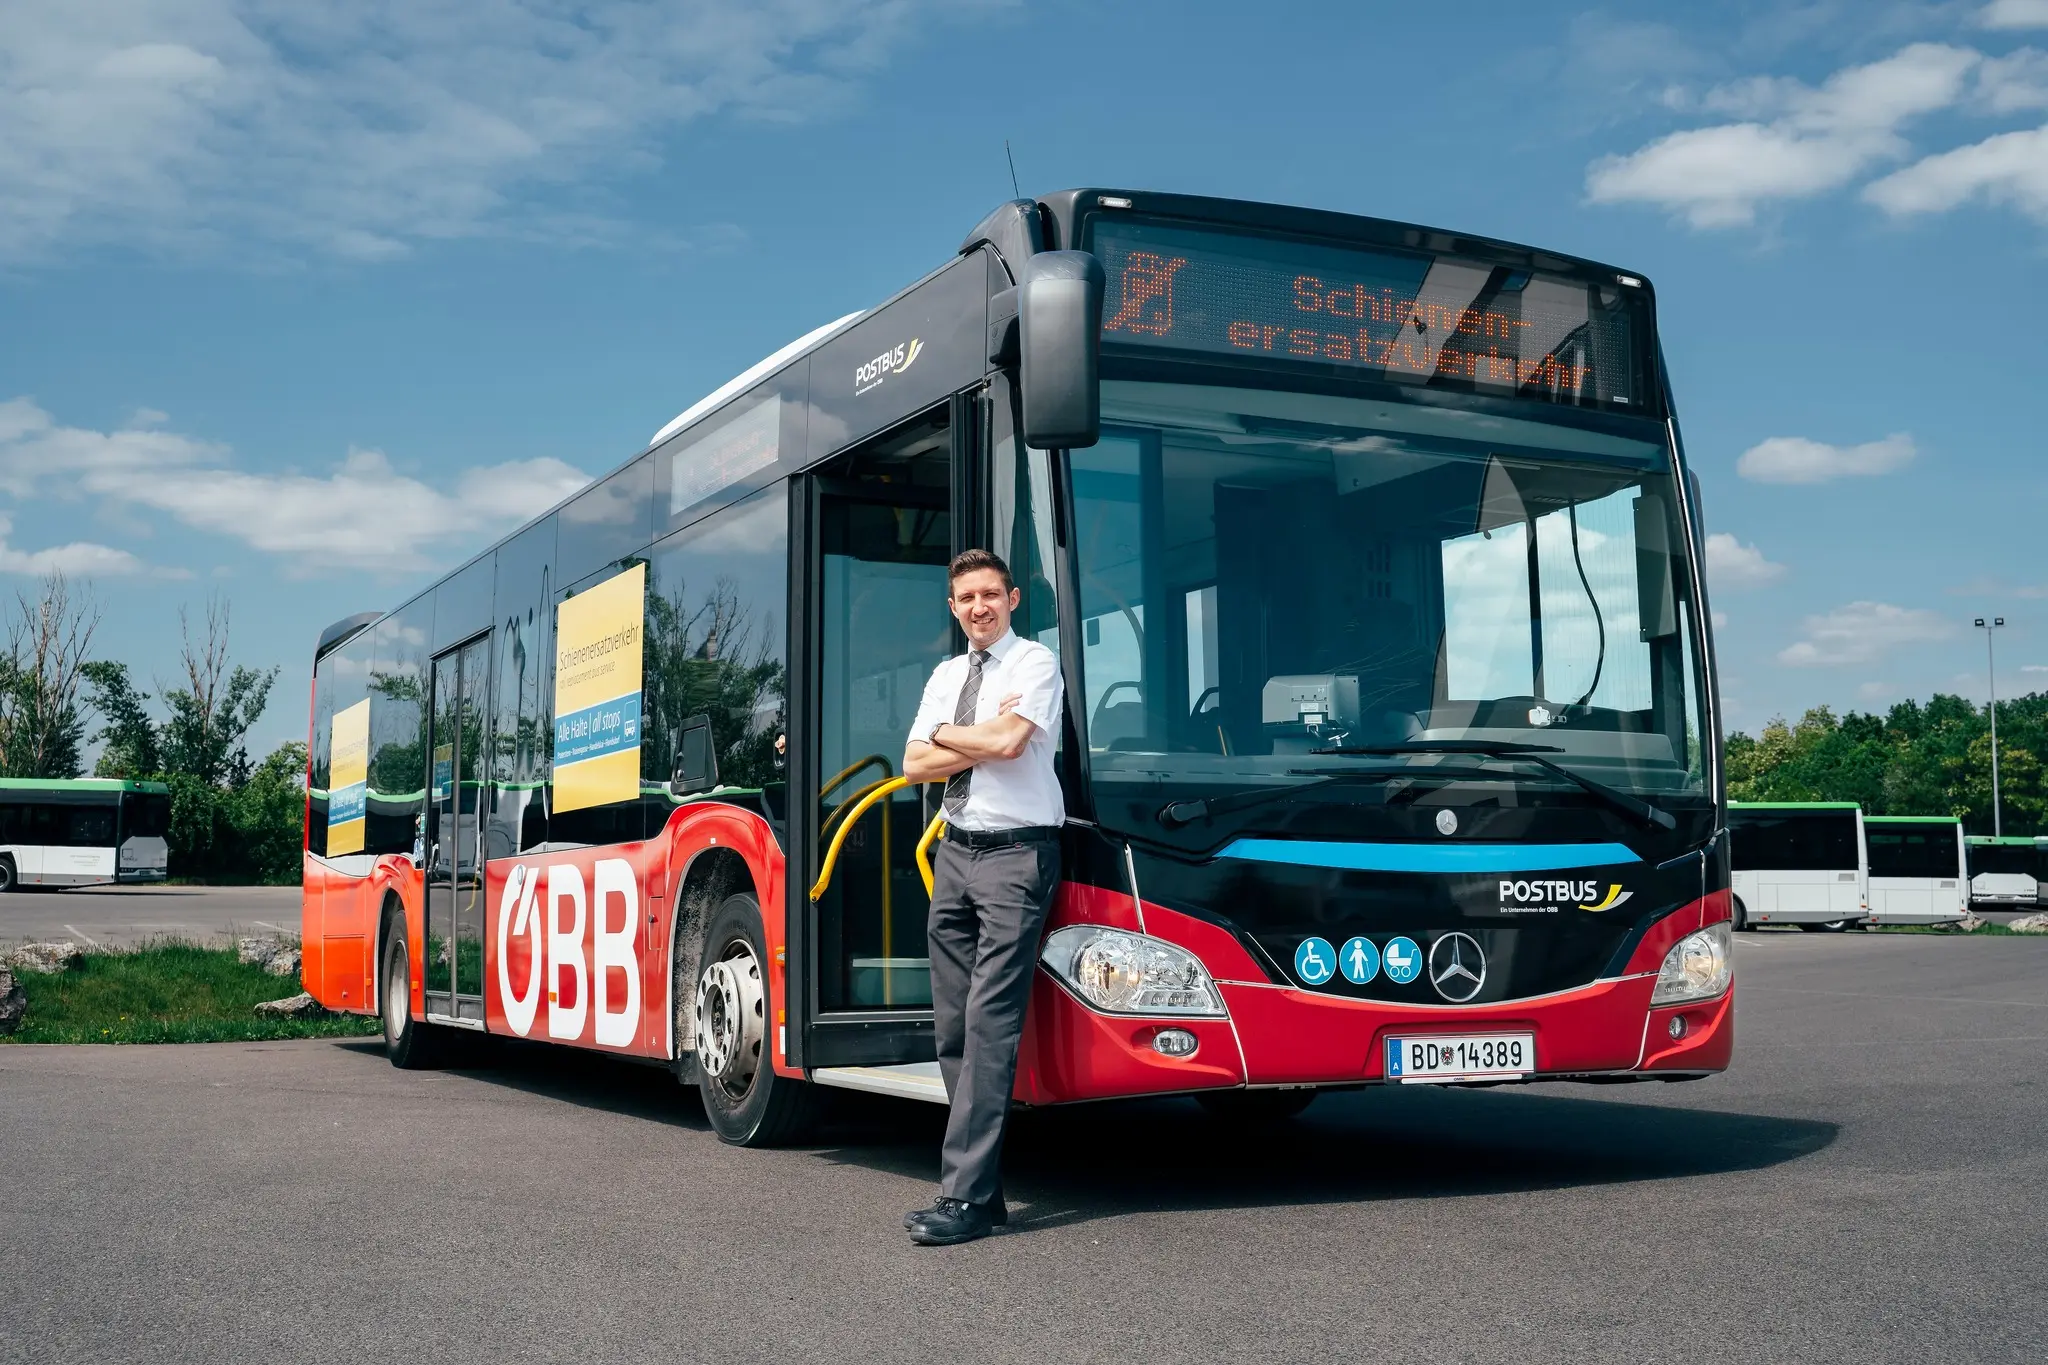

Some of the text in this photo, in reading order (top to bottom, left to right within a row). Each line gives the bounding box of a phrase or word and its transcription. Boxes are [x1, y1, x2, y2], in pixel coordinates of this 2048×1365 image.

[1294, 276, 1532, 338] Schienen-
[856, 343, 905, 386] POSTBUS
[1229, 320, 1591, 388] ersatzverkehr
[560, 622, 639, 671] Schienenersatzverkehr
[558, 721, 570, 743] Alle
[571, 717, 588, 739] Halte
[592, 710, 602, 733] all
[602, 710, 621, 734] stops
[1499, 880, 1598, 902] POSTBUS
[498, 858, 641, 1047] ÖBB
[1393, 1041, 1522, 1071] A BD 14389
